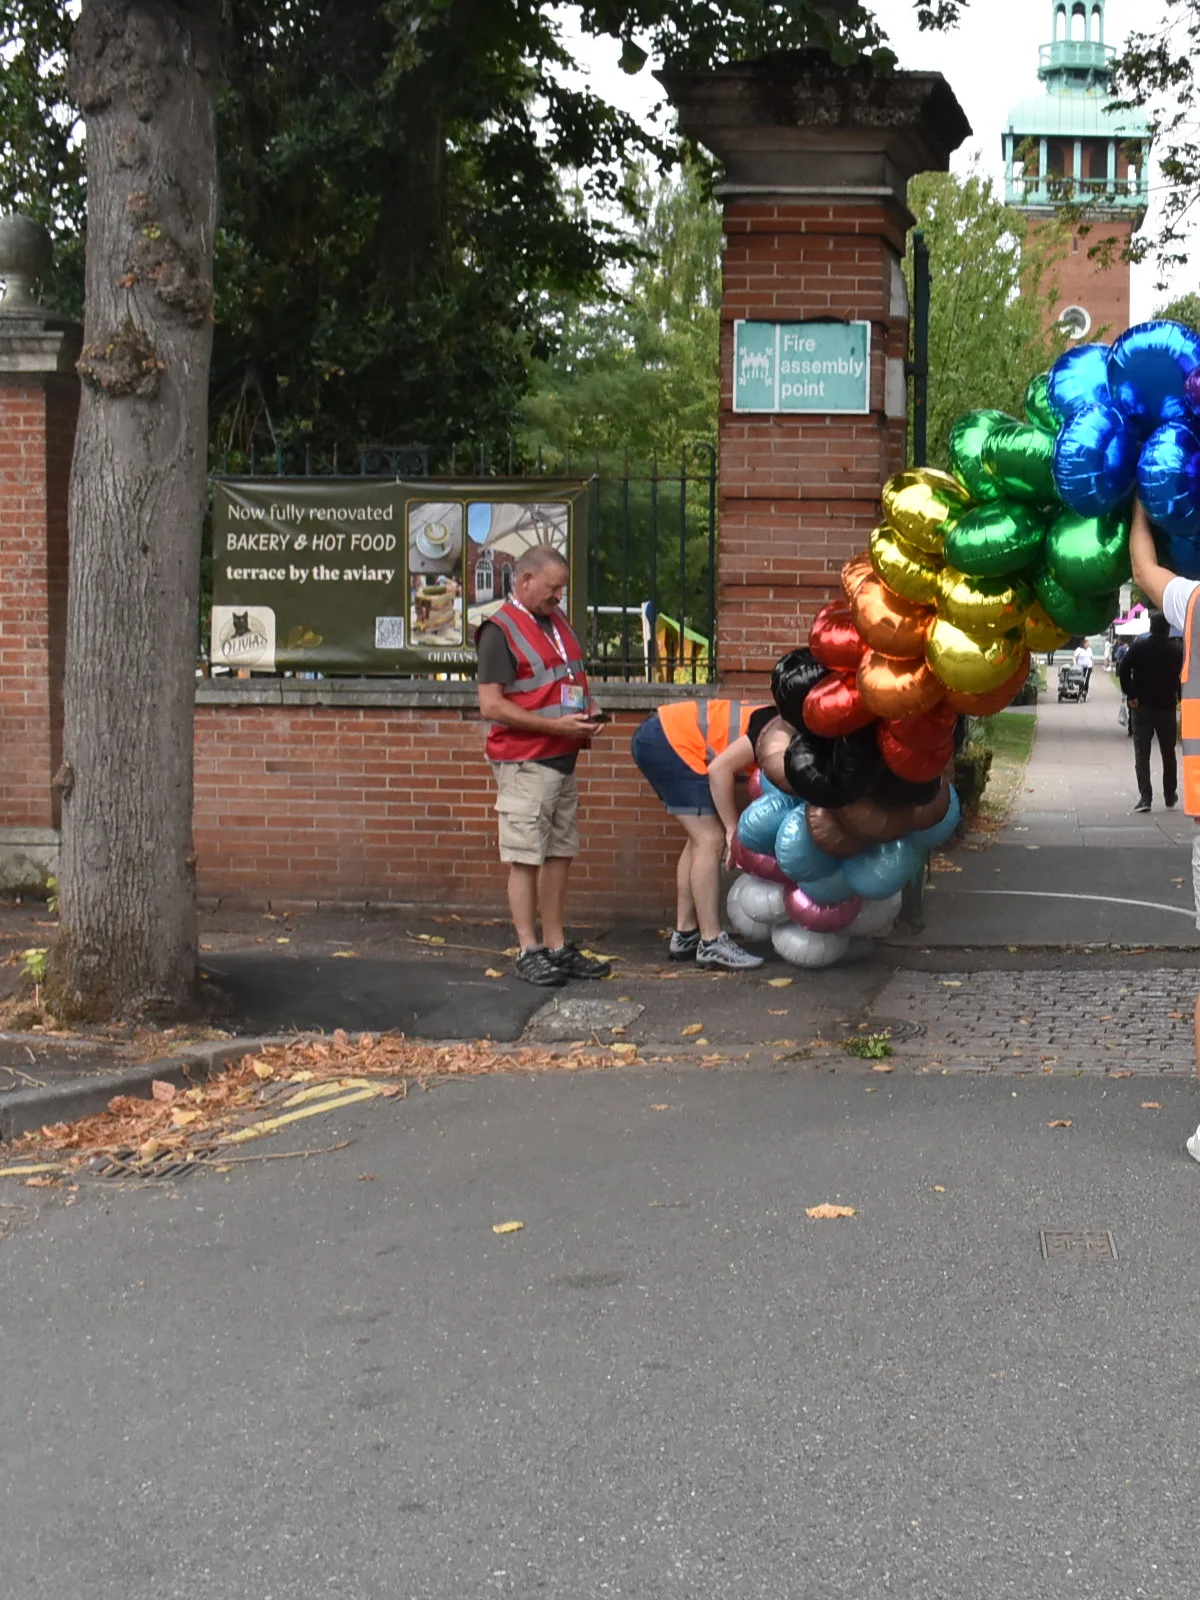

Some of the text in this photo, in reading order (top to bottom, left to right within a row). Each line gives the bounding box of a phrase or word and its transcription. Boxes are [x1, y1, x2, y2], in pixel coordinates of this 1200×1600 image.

[784, 334, 816, 352] Fire
[780, 357, 864, 378] assembly
[781, 380, 825, 399] point
[227, 504, 393, 524] Now fully renovated
[226, 533, 397, 551] BAKERY & HOT FOOD
[226, 564, 396, 584] terrace by the aviary
